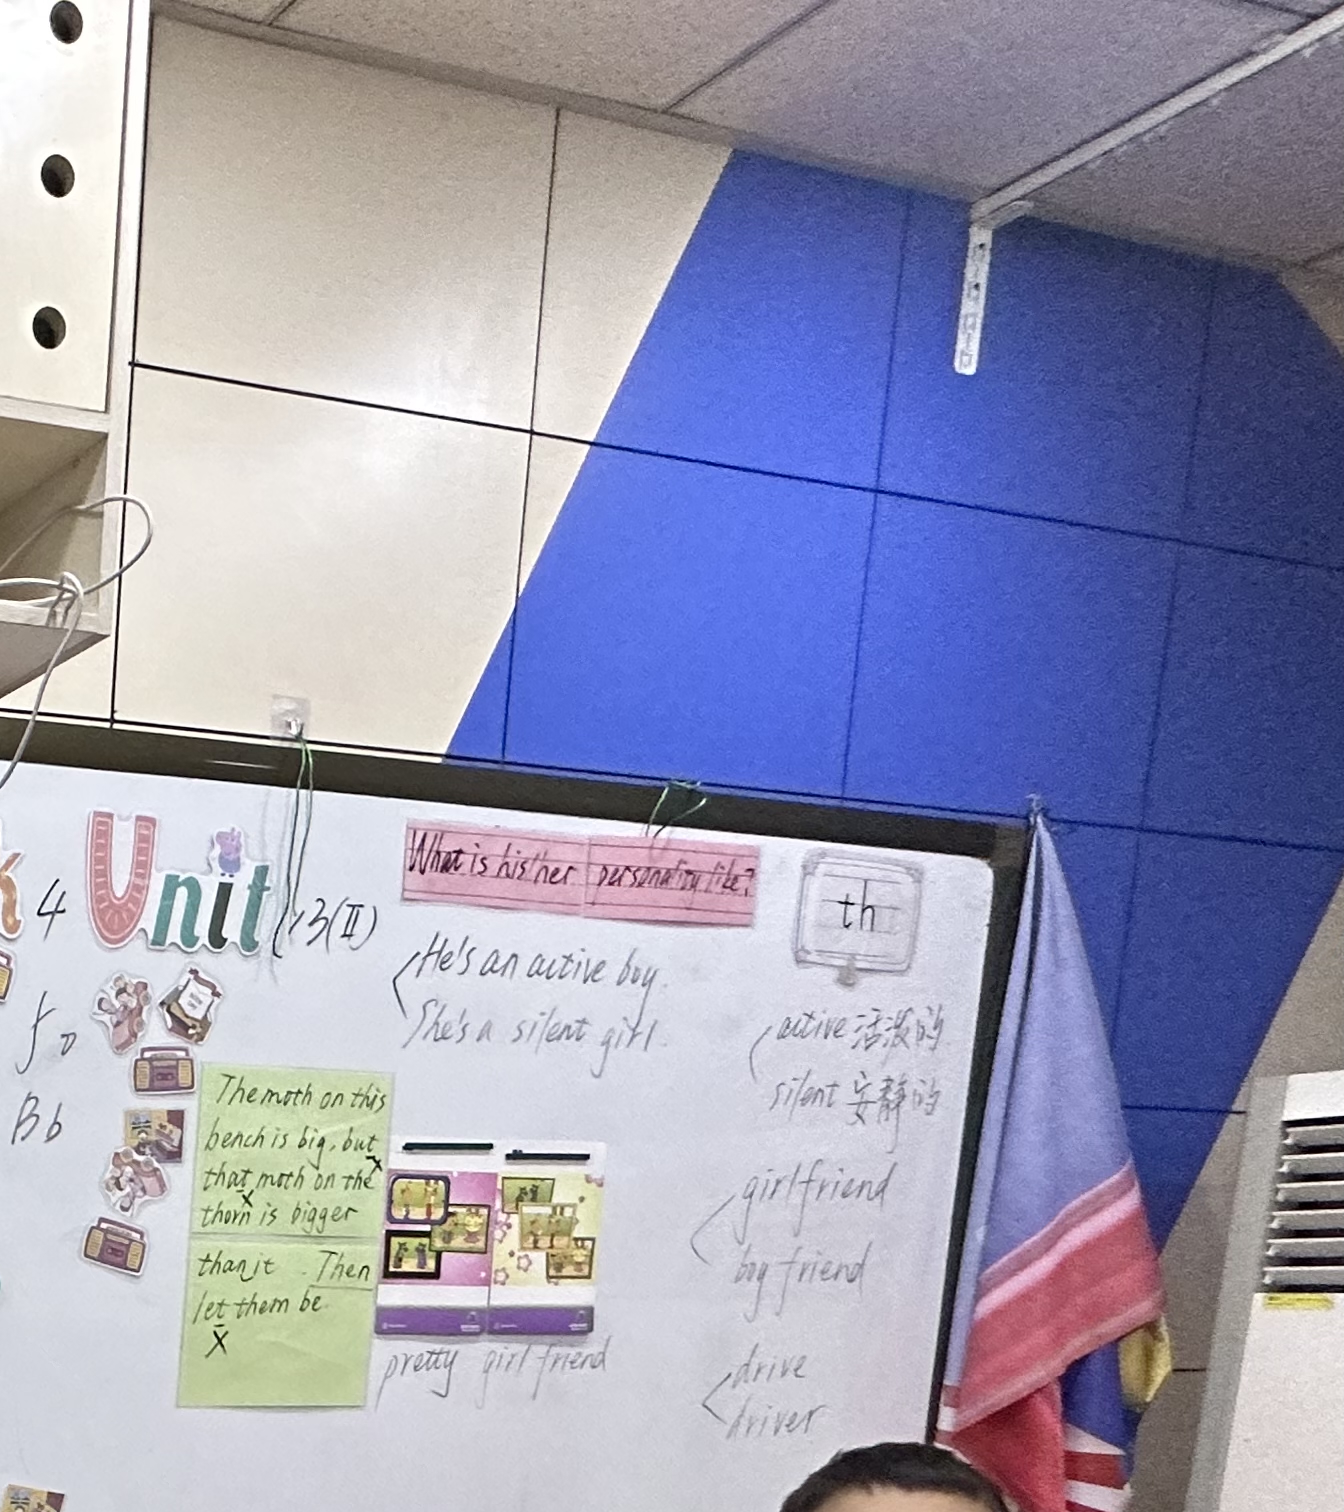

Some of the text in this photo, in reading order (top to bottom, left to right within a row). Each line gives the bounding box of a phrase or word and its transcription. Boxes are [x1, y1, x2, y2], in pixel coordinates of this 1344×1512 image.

[408, 828, 464, 875] What
[470, 843, 488, 877] is
[37, 878, 66, 941] 4
[90, 811, 270, 953] Unit
[837, 880, 875, 932] th
[415, 931, 477, 978] He's
[479, 948, 519, 977] an
[526, 948, 606, 984] active
[402, 999, 469, 1049] She's
[476, 1019, 492, 1043] a
[512, 1006, 590, 1054] silent
[216, 1073, 386, 1113] The moth on this
[769, 1069, 941, 1153] silent 安静的
[11, 1092, 62, 1145] Bb
[204, 1118, 265, 1151] bench
[271, 1127, 288, 1149] is
[342, 1127, 377, 1153] but
[202, 1162, 373, 1191] that moth on the
[200, 1203, 357, 1234] thorn is bigger
[315, 1250, 369, 1281] Then
[193, 1291, 226, 1323] let
[235, 1297, 289, 1320] them
[374, 1349, 458, 1412] pretty
[732, 1343, 807, 1389] drive
